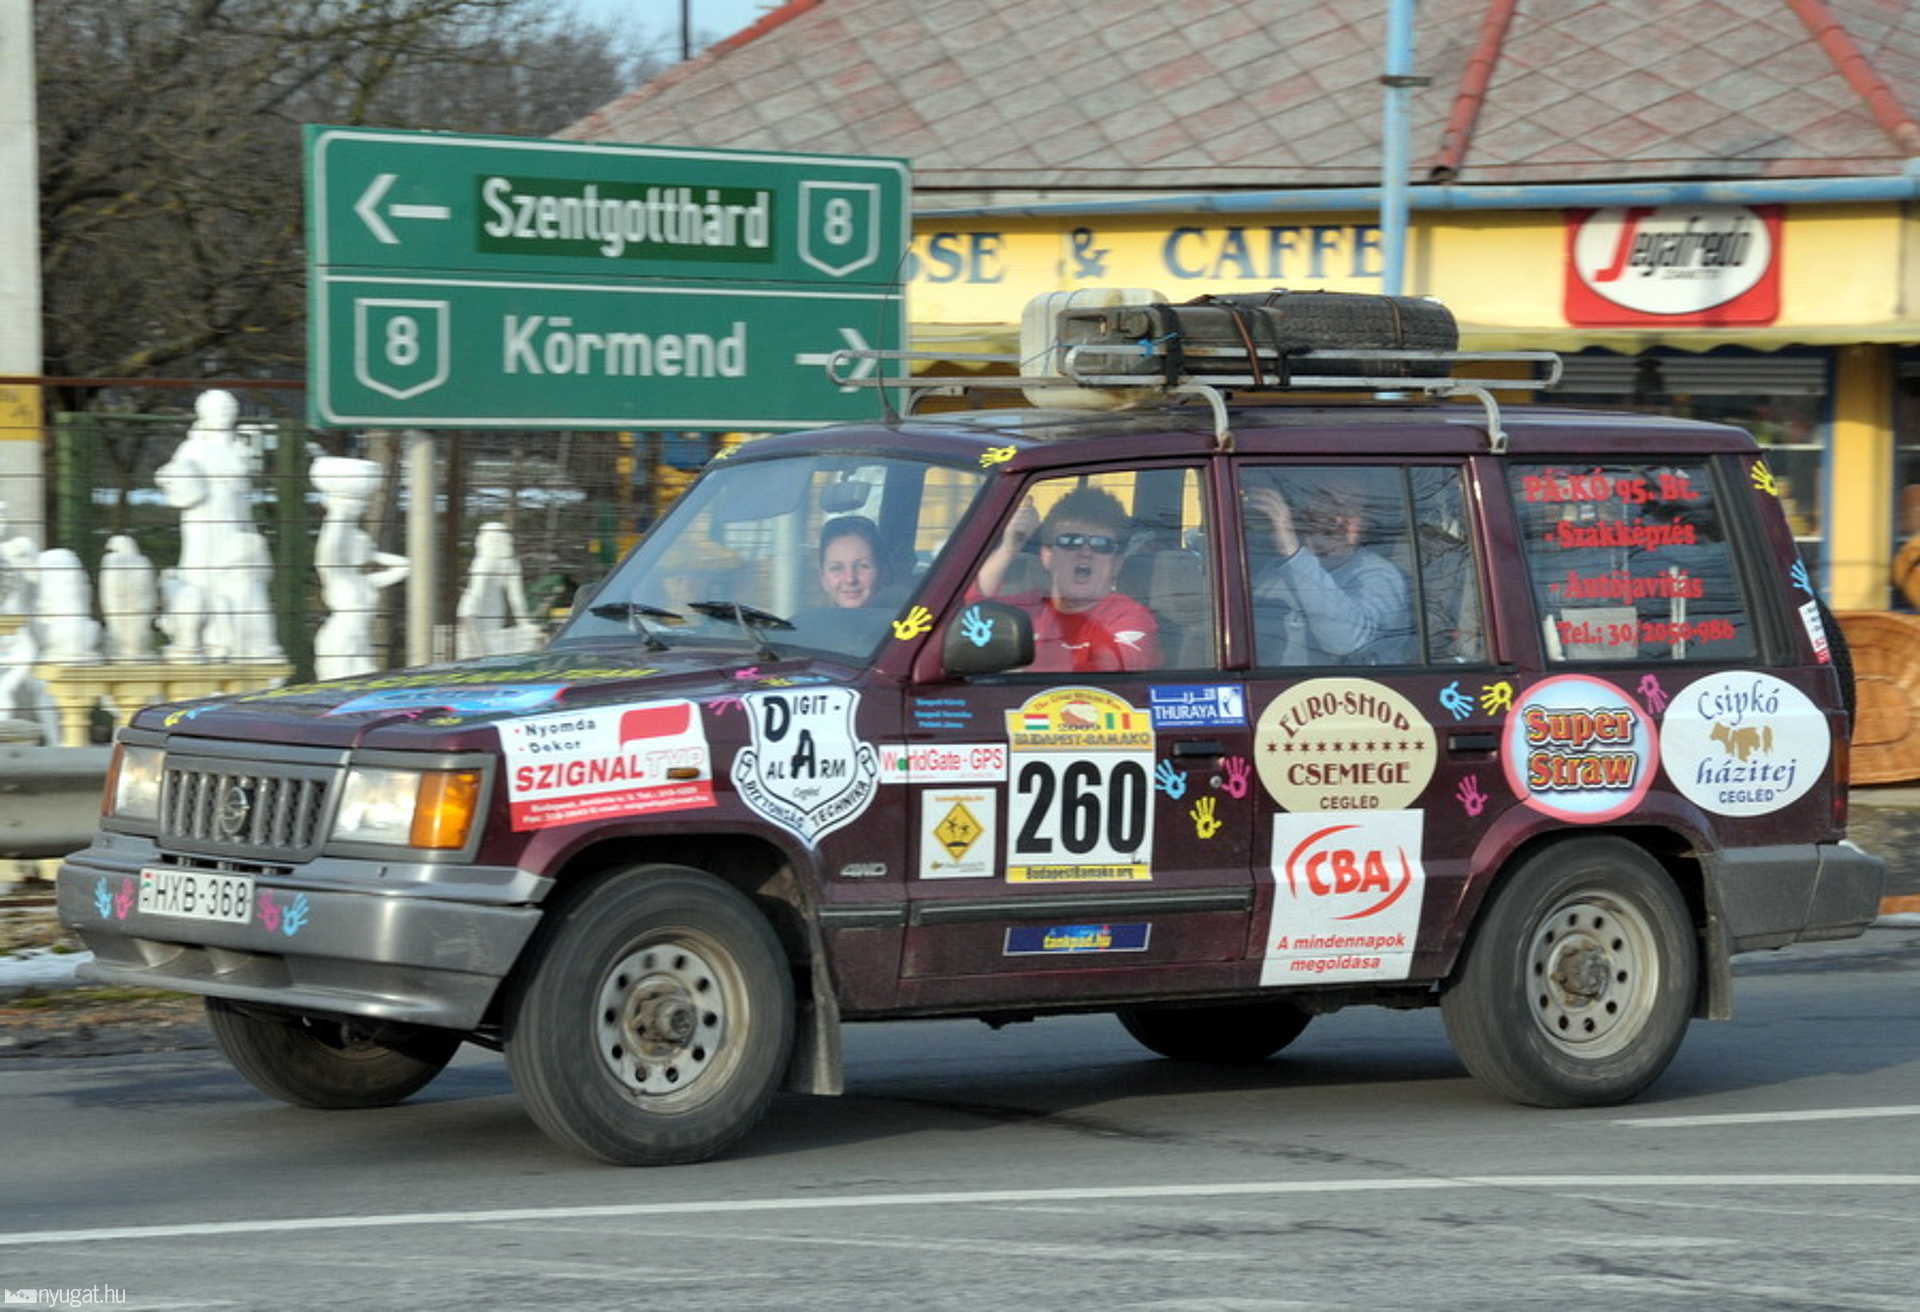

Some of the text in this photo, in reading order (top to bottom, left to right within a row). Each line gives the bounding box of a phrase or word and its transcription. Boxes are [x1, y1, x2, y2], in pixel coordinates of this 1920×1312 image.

[483, 177, 770, 257] Szentgotthárd
[824, 198, 854, 246] 8
[385, 316, 419, 366] 8
[525, 719, 596, 738] Nyomda
[1153, 704, 1217, 719] THURAYA
[1280, 691, 1410, 738] EURO-SHOP
[1524, 707, 1635, 750] Super
[529, 740, 581, 754] Dekor
[1288, 761, 1411, 785] CSEMEGE
[1529, 752, 1637, 789] Straw
[1696, 757, 1797, 792] házitej
[1015, 760, 1148, 855] 260
[1305, 849, 1390, 896] CBA
[1277, 933, 1406, 950] A mindennapok
